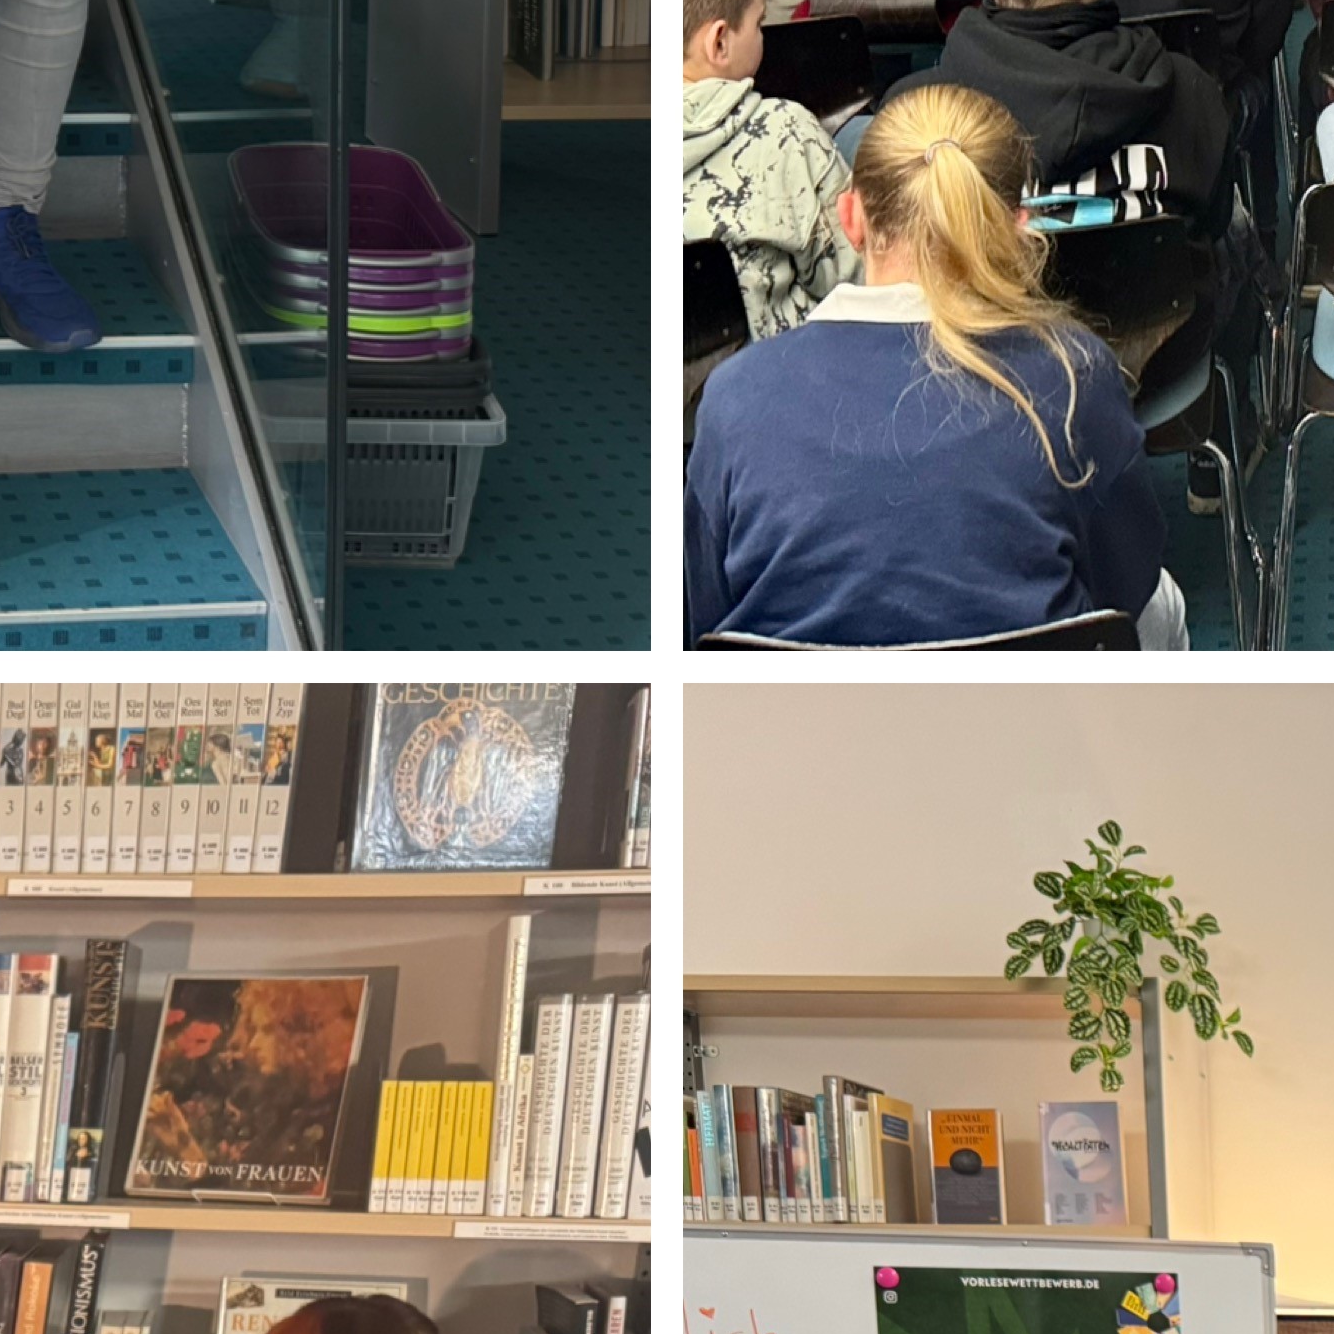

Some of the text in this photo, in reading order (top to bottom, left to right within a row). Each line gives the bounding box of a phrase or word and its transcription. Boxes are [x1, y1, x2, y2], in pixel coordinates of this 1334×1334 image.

[5, 800, 14, 815] 3
[34, 800, 43, 815] 4
[63, 800, 72, 815] 5
[91, 800, 100, 816] 6
[125, 800, 133, 816] 7
[151, 800, 161, 816] 8
[180, 799, 190, 815] 9
[206, 799, 220, 815] 10
[239, 798, 248, 814] 11
[266, 800, 280, 816] 12
[543, 1010, 553, 1035] DER
[581, 1009, 591, 1034] DER
[622, 1008, 633, 1034] DER
[9, 1066, 43, 1079] STIL
[20, 1087, 27, 1096] 3
[516, 1094, 528, 1128] Afrika
[939, 1125, 991, 1134] UND NICHT
[135, 1159, 324, 1182] KUNST VON FRAUEN
[960, 1276, 1101, 1290] VORLESEWETTBEWERB.DE
